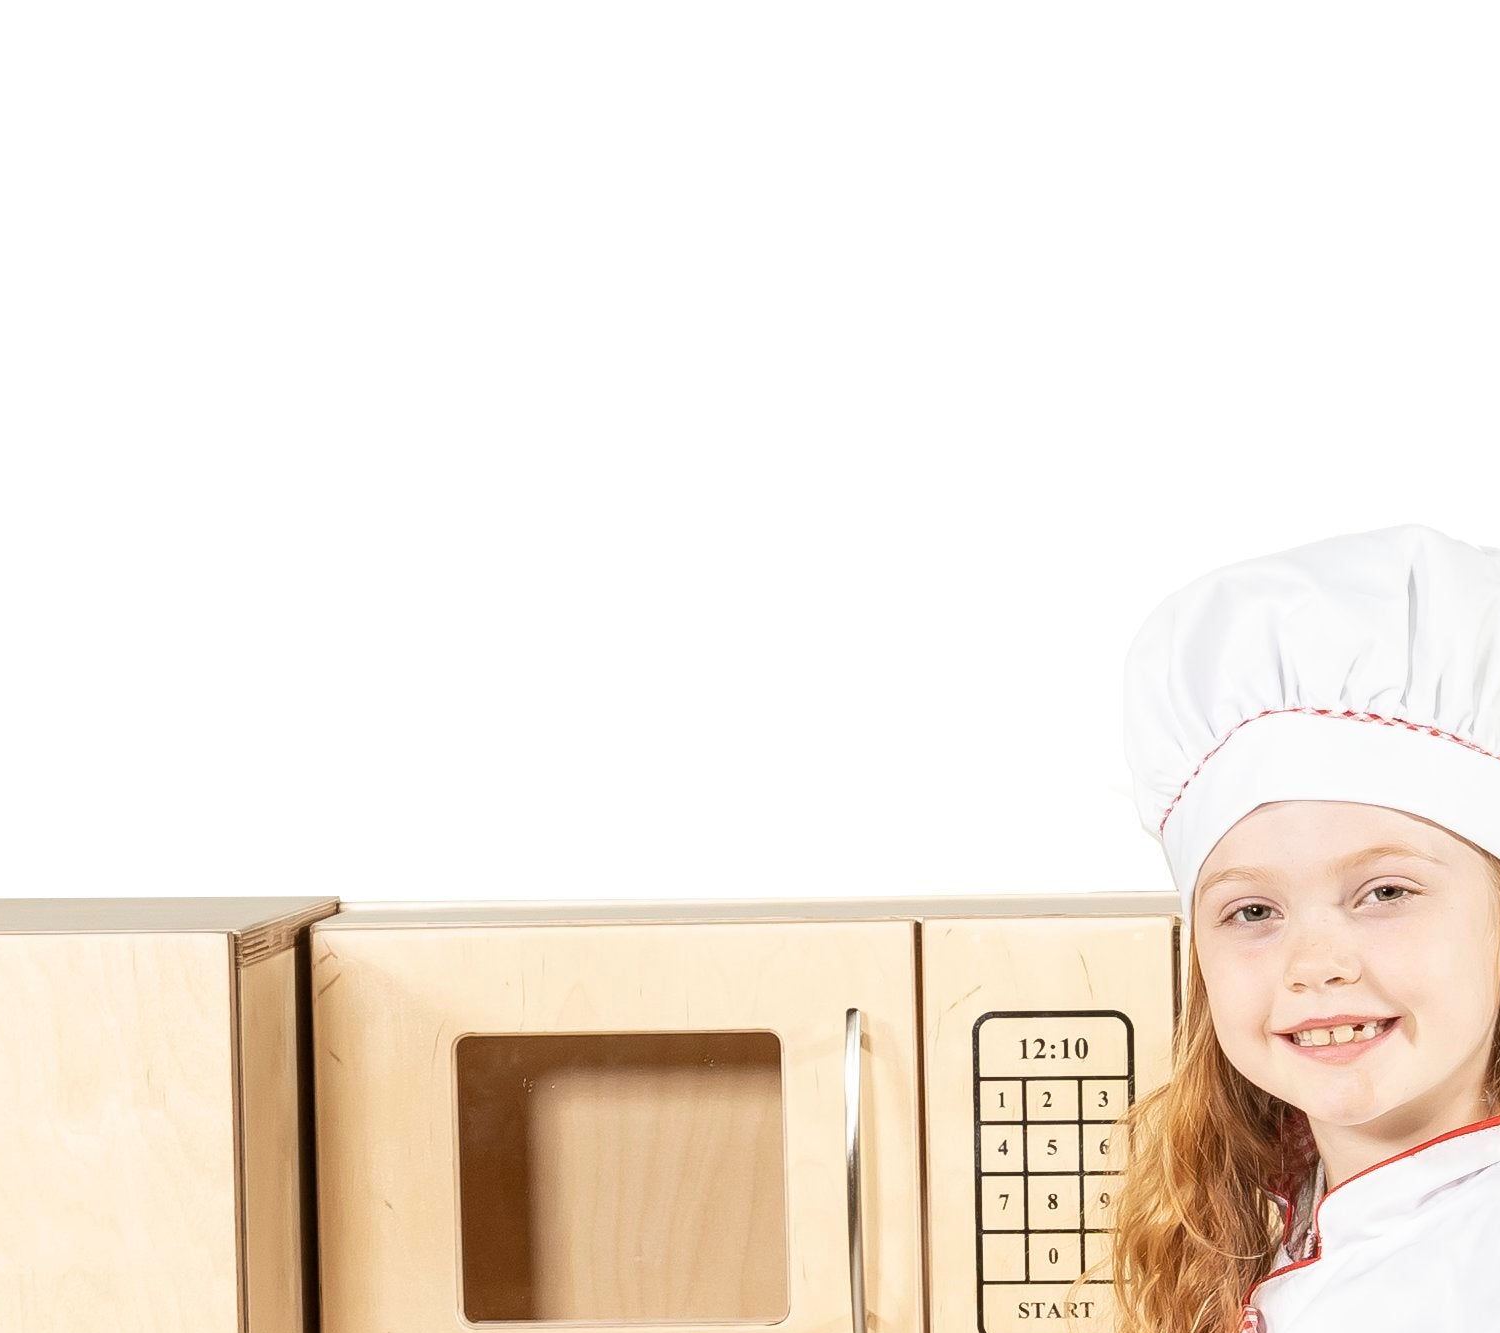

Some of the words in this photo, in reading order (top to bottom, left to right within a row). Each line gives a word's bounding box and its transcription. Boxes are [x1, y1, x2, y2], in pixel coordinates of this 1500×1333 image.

[1018, 1037, 1089, 1060] 12:10
[997, 1091, 1007, 1109] 1
[1041, 1091, 1053, 1109] 2
[1097, 1090, 1109, 1109] 3
[997, 1139, 1009, 1156] 4
[1046, 1139, 1058, 1156] 5
[1099, 1138, 1111, 1156] 6
[998, 1193, 1010, 1211] 7
[1047, 1193, 1059, 1211] 8
[1099, 1192, 1111, 1210] 9
[1048, 1247, 1059, 1265] 0
[1018, 1302, 1095, 1320] START
